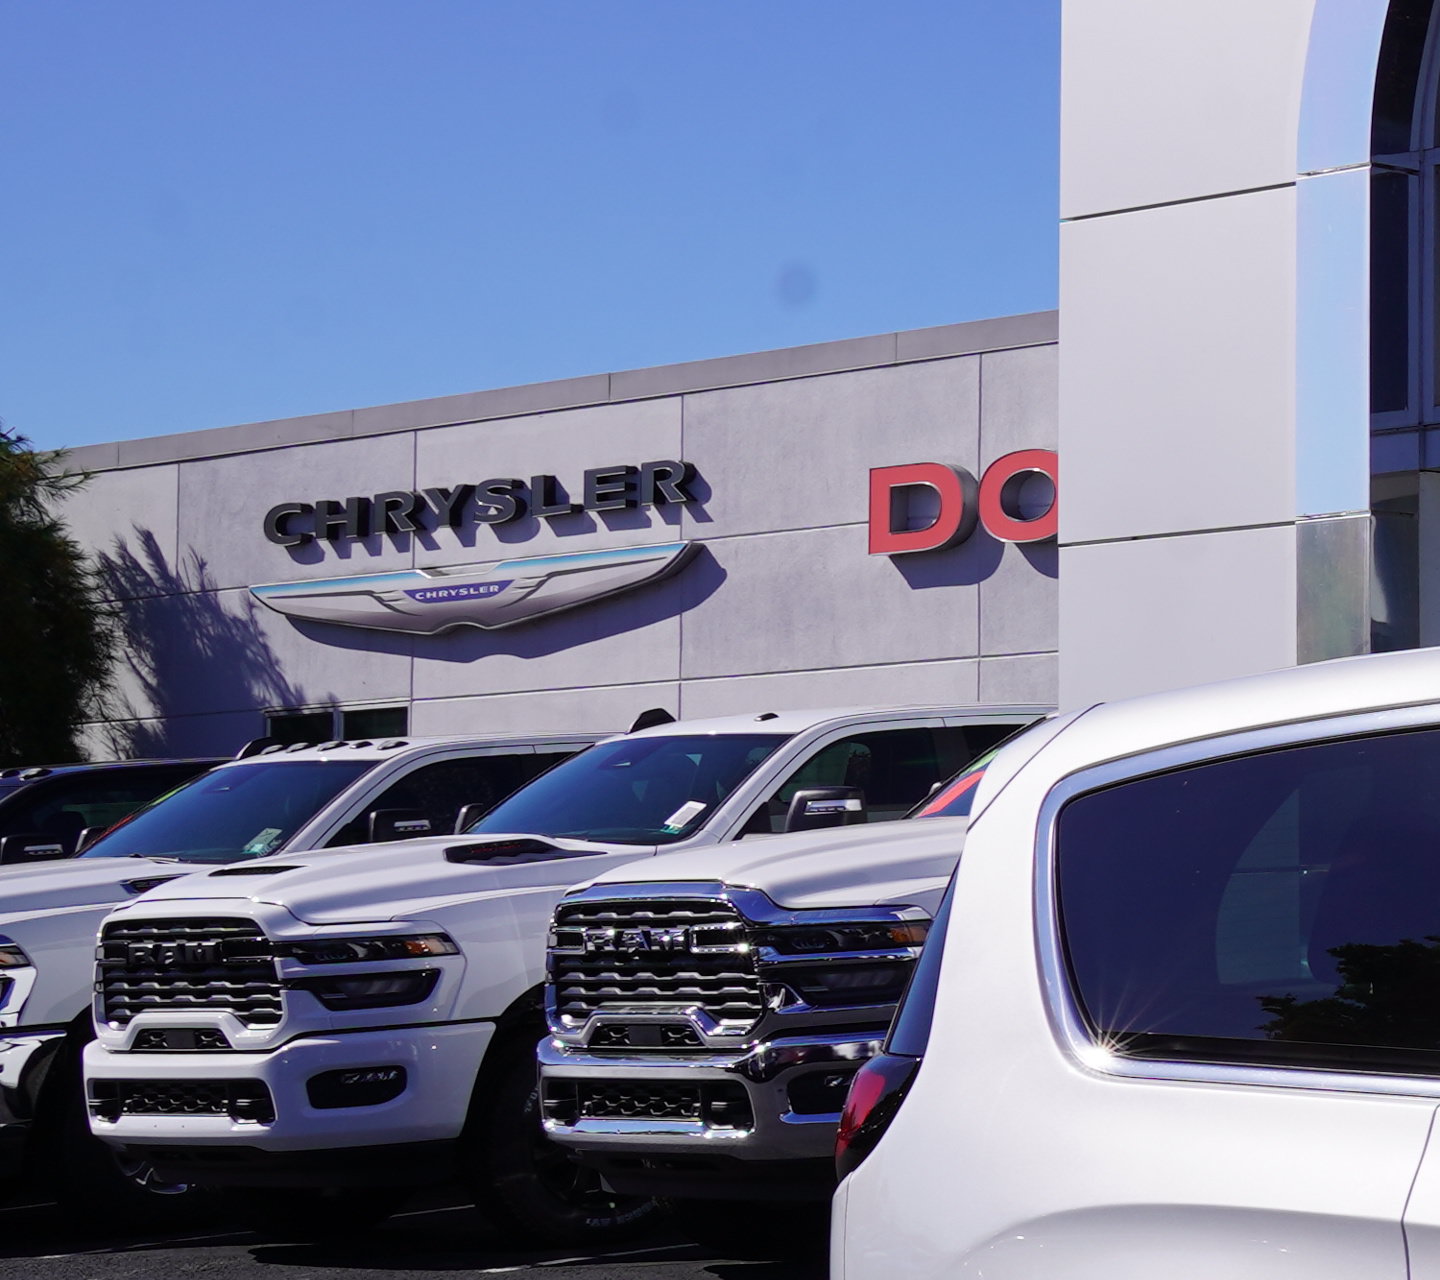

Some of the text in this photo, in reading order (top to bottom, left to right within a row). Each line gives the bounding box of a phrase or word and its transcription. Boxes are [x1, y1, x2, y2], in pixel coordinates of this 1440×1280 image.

[263, 459, 698, 546] CHRYSLER
[415, 584, 500, 600] CHRYSLER
[585, 927, 688, 951] RAM
[128, 940, 218, 964] RAM
